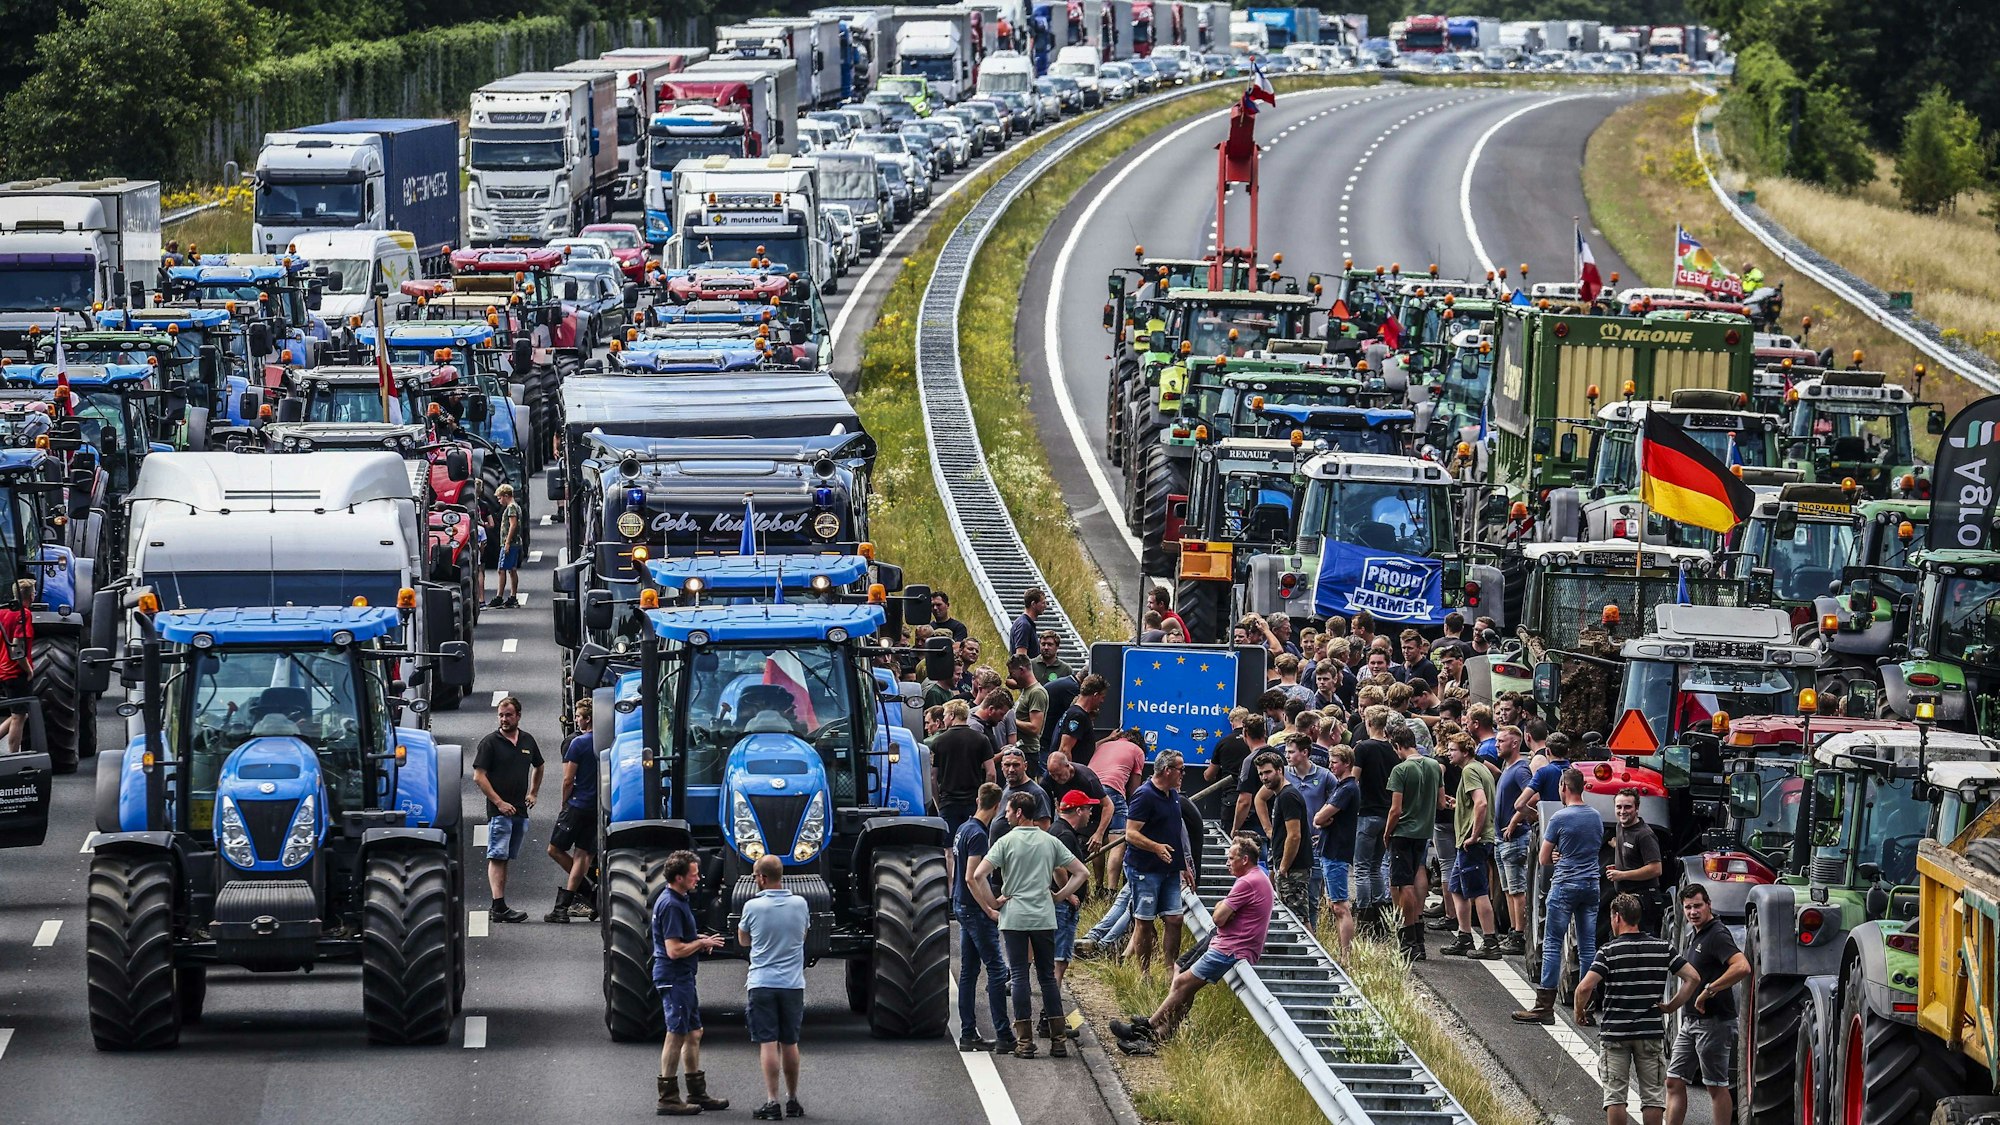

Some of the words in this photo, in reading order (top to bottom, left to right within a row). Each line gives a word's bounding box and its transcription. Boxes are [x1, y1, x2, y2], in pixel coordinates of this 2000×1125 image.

[730, 216, 779, 224] munsterhuis
[1621, 328, 1694, 344] KRONE
[1229, 450, 1271, 459] RENAULT
[1801, 503, 1847, 514] NORMAAL
[650, 511, 702, 532] Gebr.
[1367, 565, 1423, 588] PROUD
[1374, 582, 1387, 593] TO
[1387, 585, 1401, 596] BE
[1402, 587, 1410, 597] A
[1354, 591, 1425, 613] FARMER
[1137, 700, 1220, 716] Nederland
